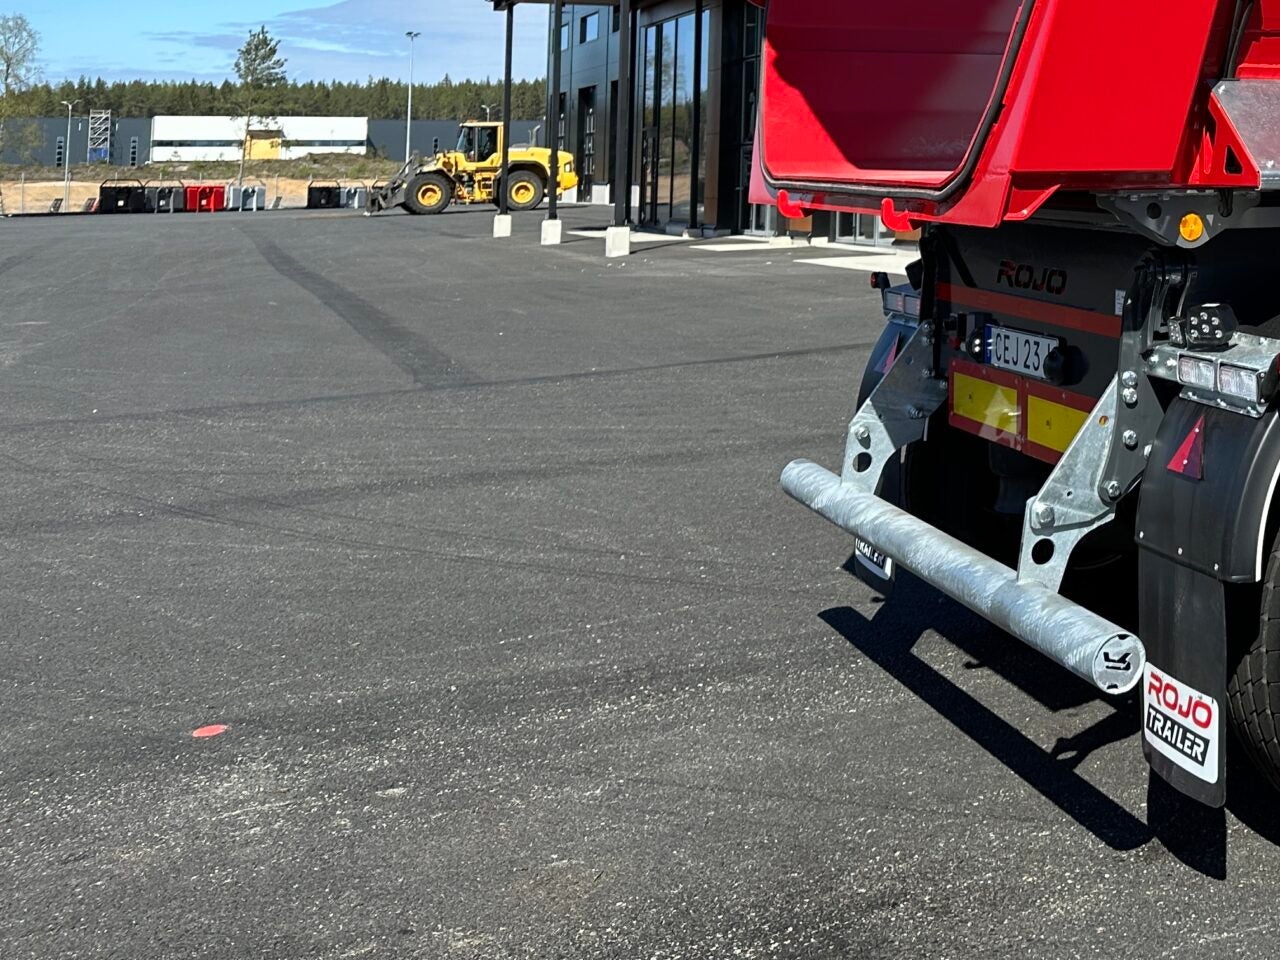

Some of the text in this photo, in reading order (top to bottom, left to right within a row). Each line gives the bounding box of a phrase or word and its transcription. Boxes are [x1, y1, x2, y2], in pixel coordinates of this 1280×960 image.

[997, 259, 1068, 295] ROJO
[995, 333, 1052, 372] CEJ 23
[1148, 671, 1213, 730] ROJO
[1147, 707, 1206, 763] TRAILER
